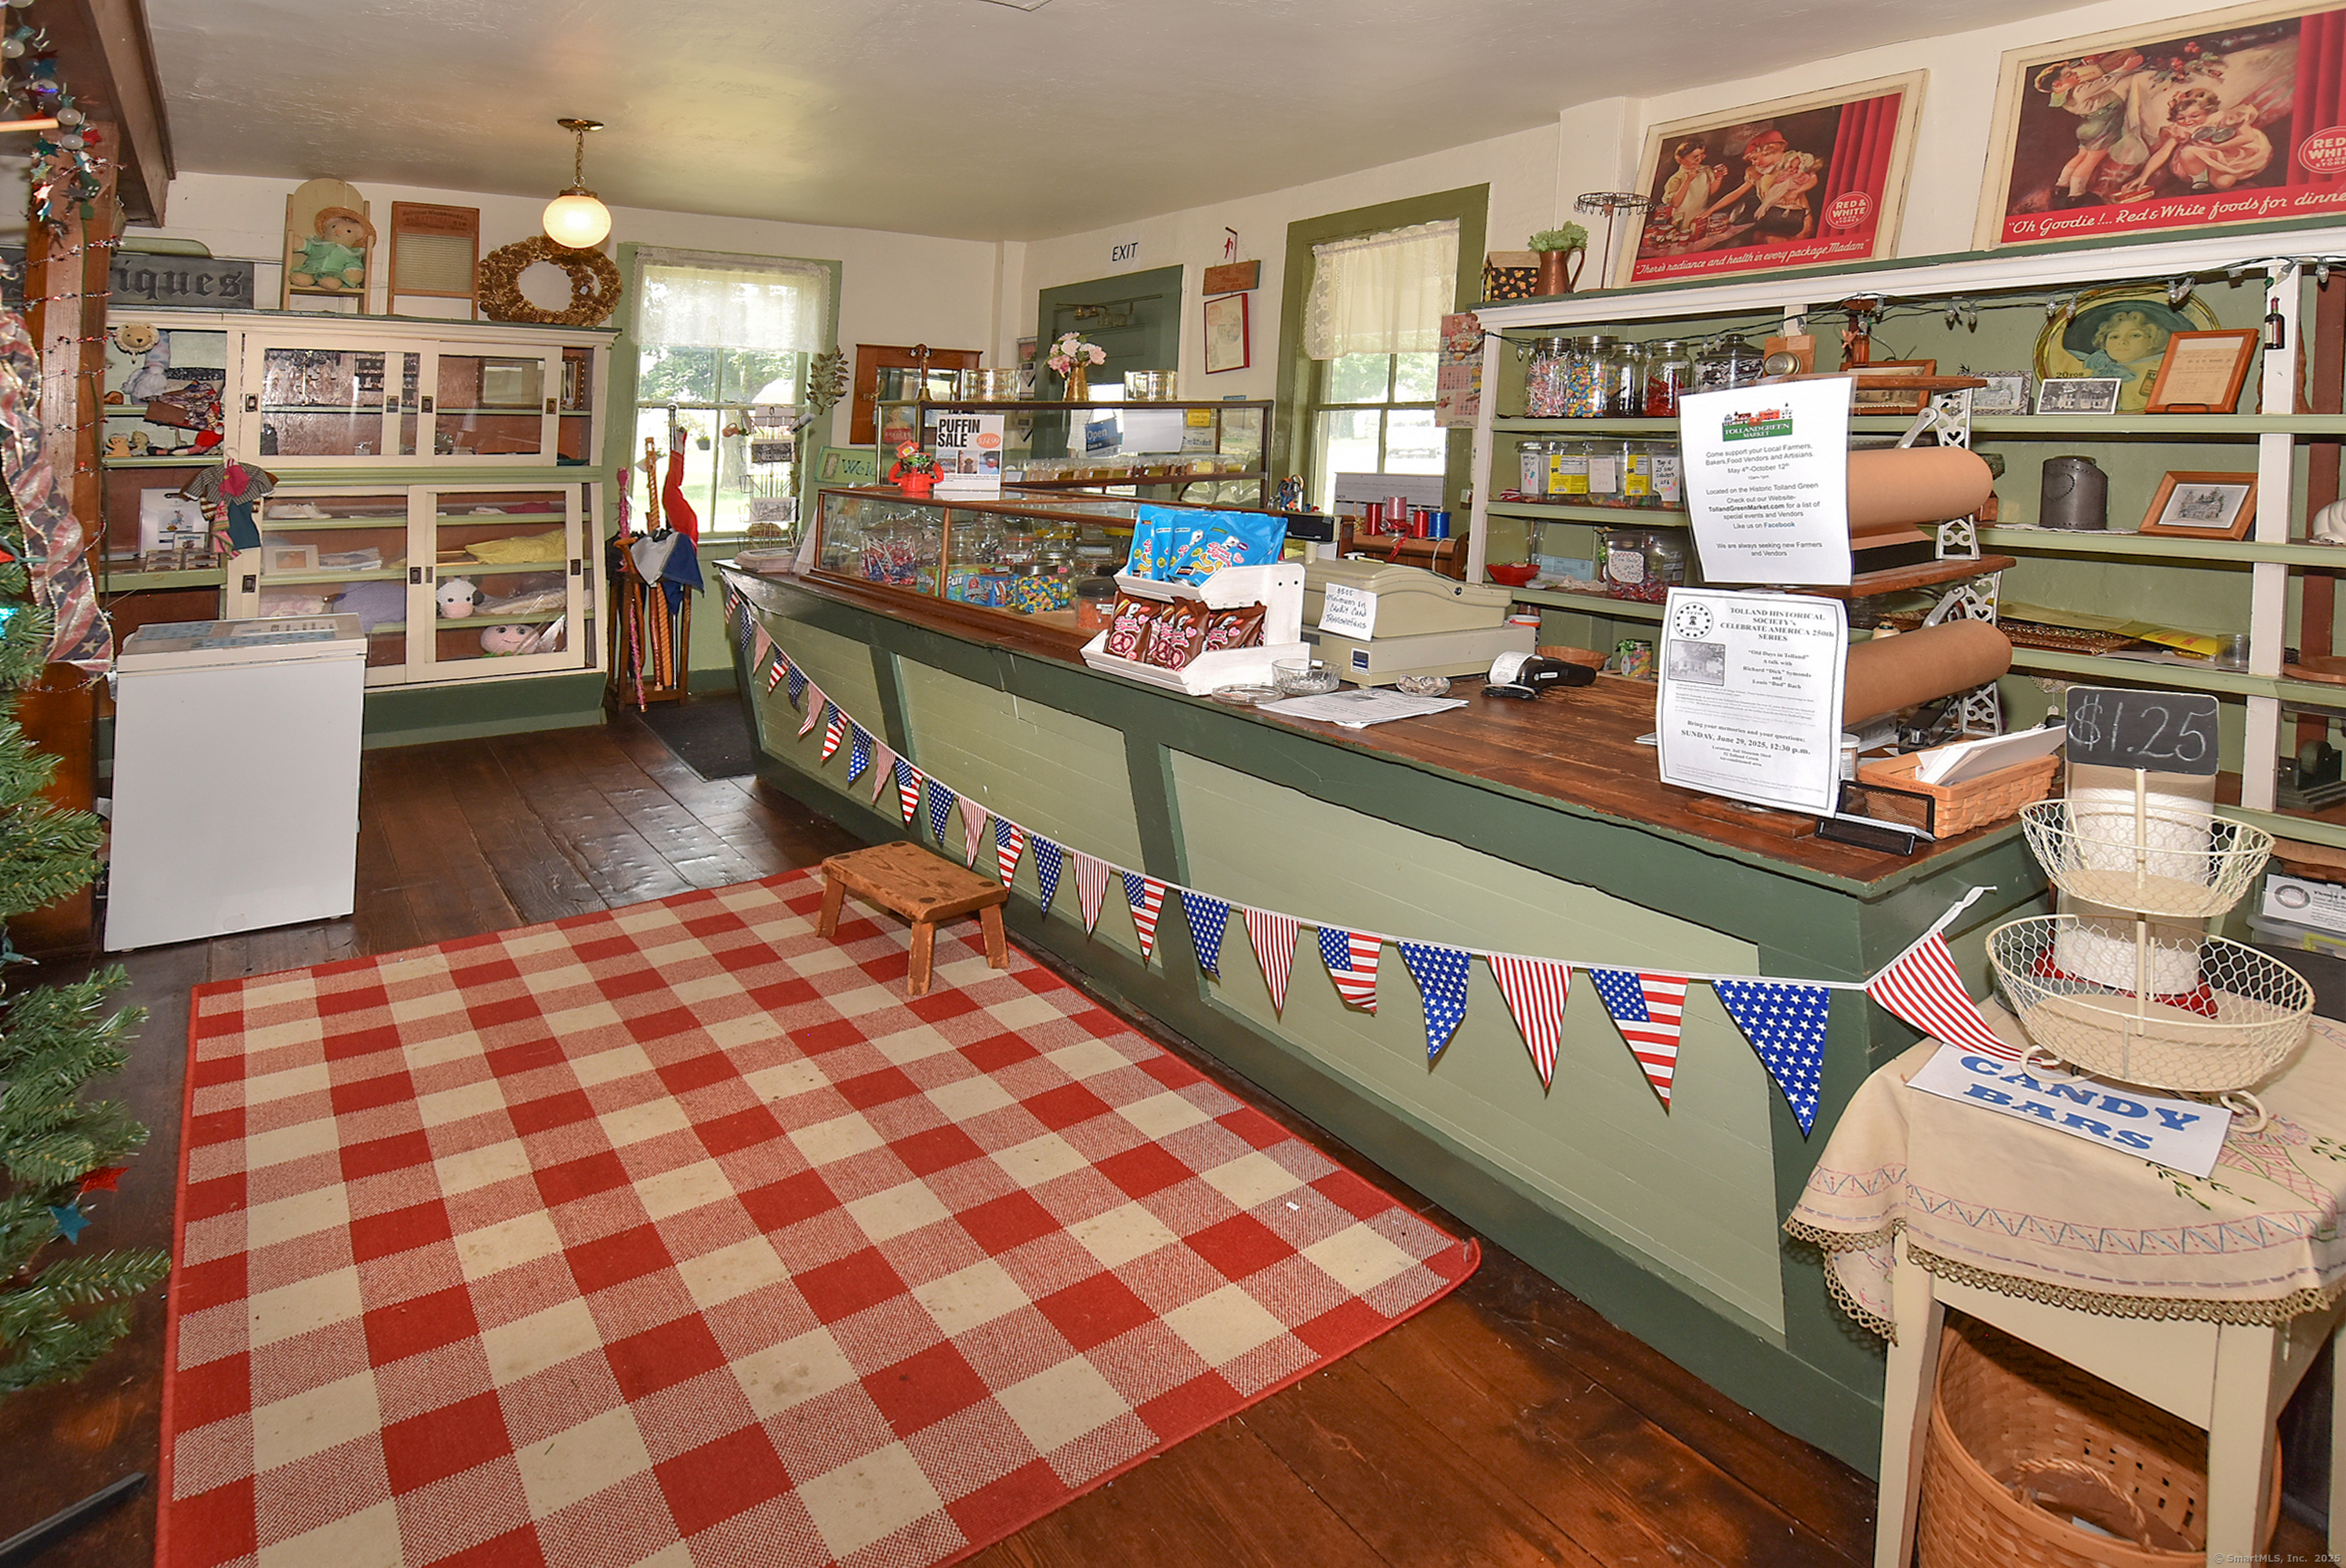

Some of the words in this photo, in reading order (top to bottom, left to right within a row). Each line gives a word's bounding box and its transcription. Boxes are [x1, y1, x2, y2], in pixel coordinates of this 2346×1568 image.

[2313, 136, 2346, 149] RED
[2308, 147, 2346, 160] WHIT
[1836, 201, 1857, 209] RED
[1832, 207, 1866, 218] WHITE
[2039, 215, 2095, 237] Goodie
[2115, 209, 2149, 223] Red
[2149, 210, 2159, 220] &
[2159, 204, 2206, 218] White
[2208, 198, 2259, 220] foods
[2258, 196, 2287, 215] for
[2294, 192, 2346, 205] dinne
[1112, 242, 1138, 262] EXIT
[1666, 260, 1705, 271] radiance
[1708, 256, 1726, 267] and
[1727, 252, 1753, 264] health
[1754, 251, 1763, 261] in
[1764, 250, 1789, 263] every
[118, 260, 244, 301] iques
[939, 419, 980, 433] PUFFIN
[1725, 426, 1761, 435] TOLLAND
[938, 434, 968, 448] SALE
[1087, 428, 1107, 441] Open
[841, 459, 876, 476] Welc
[1709, 503, 1785, 512] TollandGreenMarket.com
[1730, 607, 1768, 616] TOLLAND
[1770, 611, 1825, 620] HISTORICAL
[1720, 622, 1767, 632] CELEBRATE
[1769, 626, 1810, 636] AMERICA
[1718, 725, 1745, 734] memories
[2068, 694, 2216, 761] $1.25
[1716, 735, 1734, 743] June
[1770, 742, 1790, 752] 12:30
[1792, 746, 1810, 755] p.m.
[1960, 1056, 2200, 1131] CANDY
[1963, 1083, 2153, 1149] BARS
